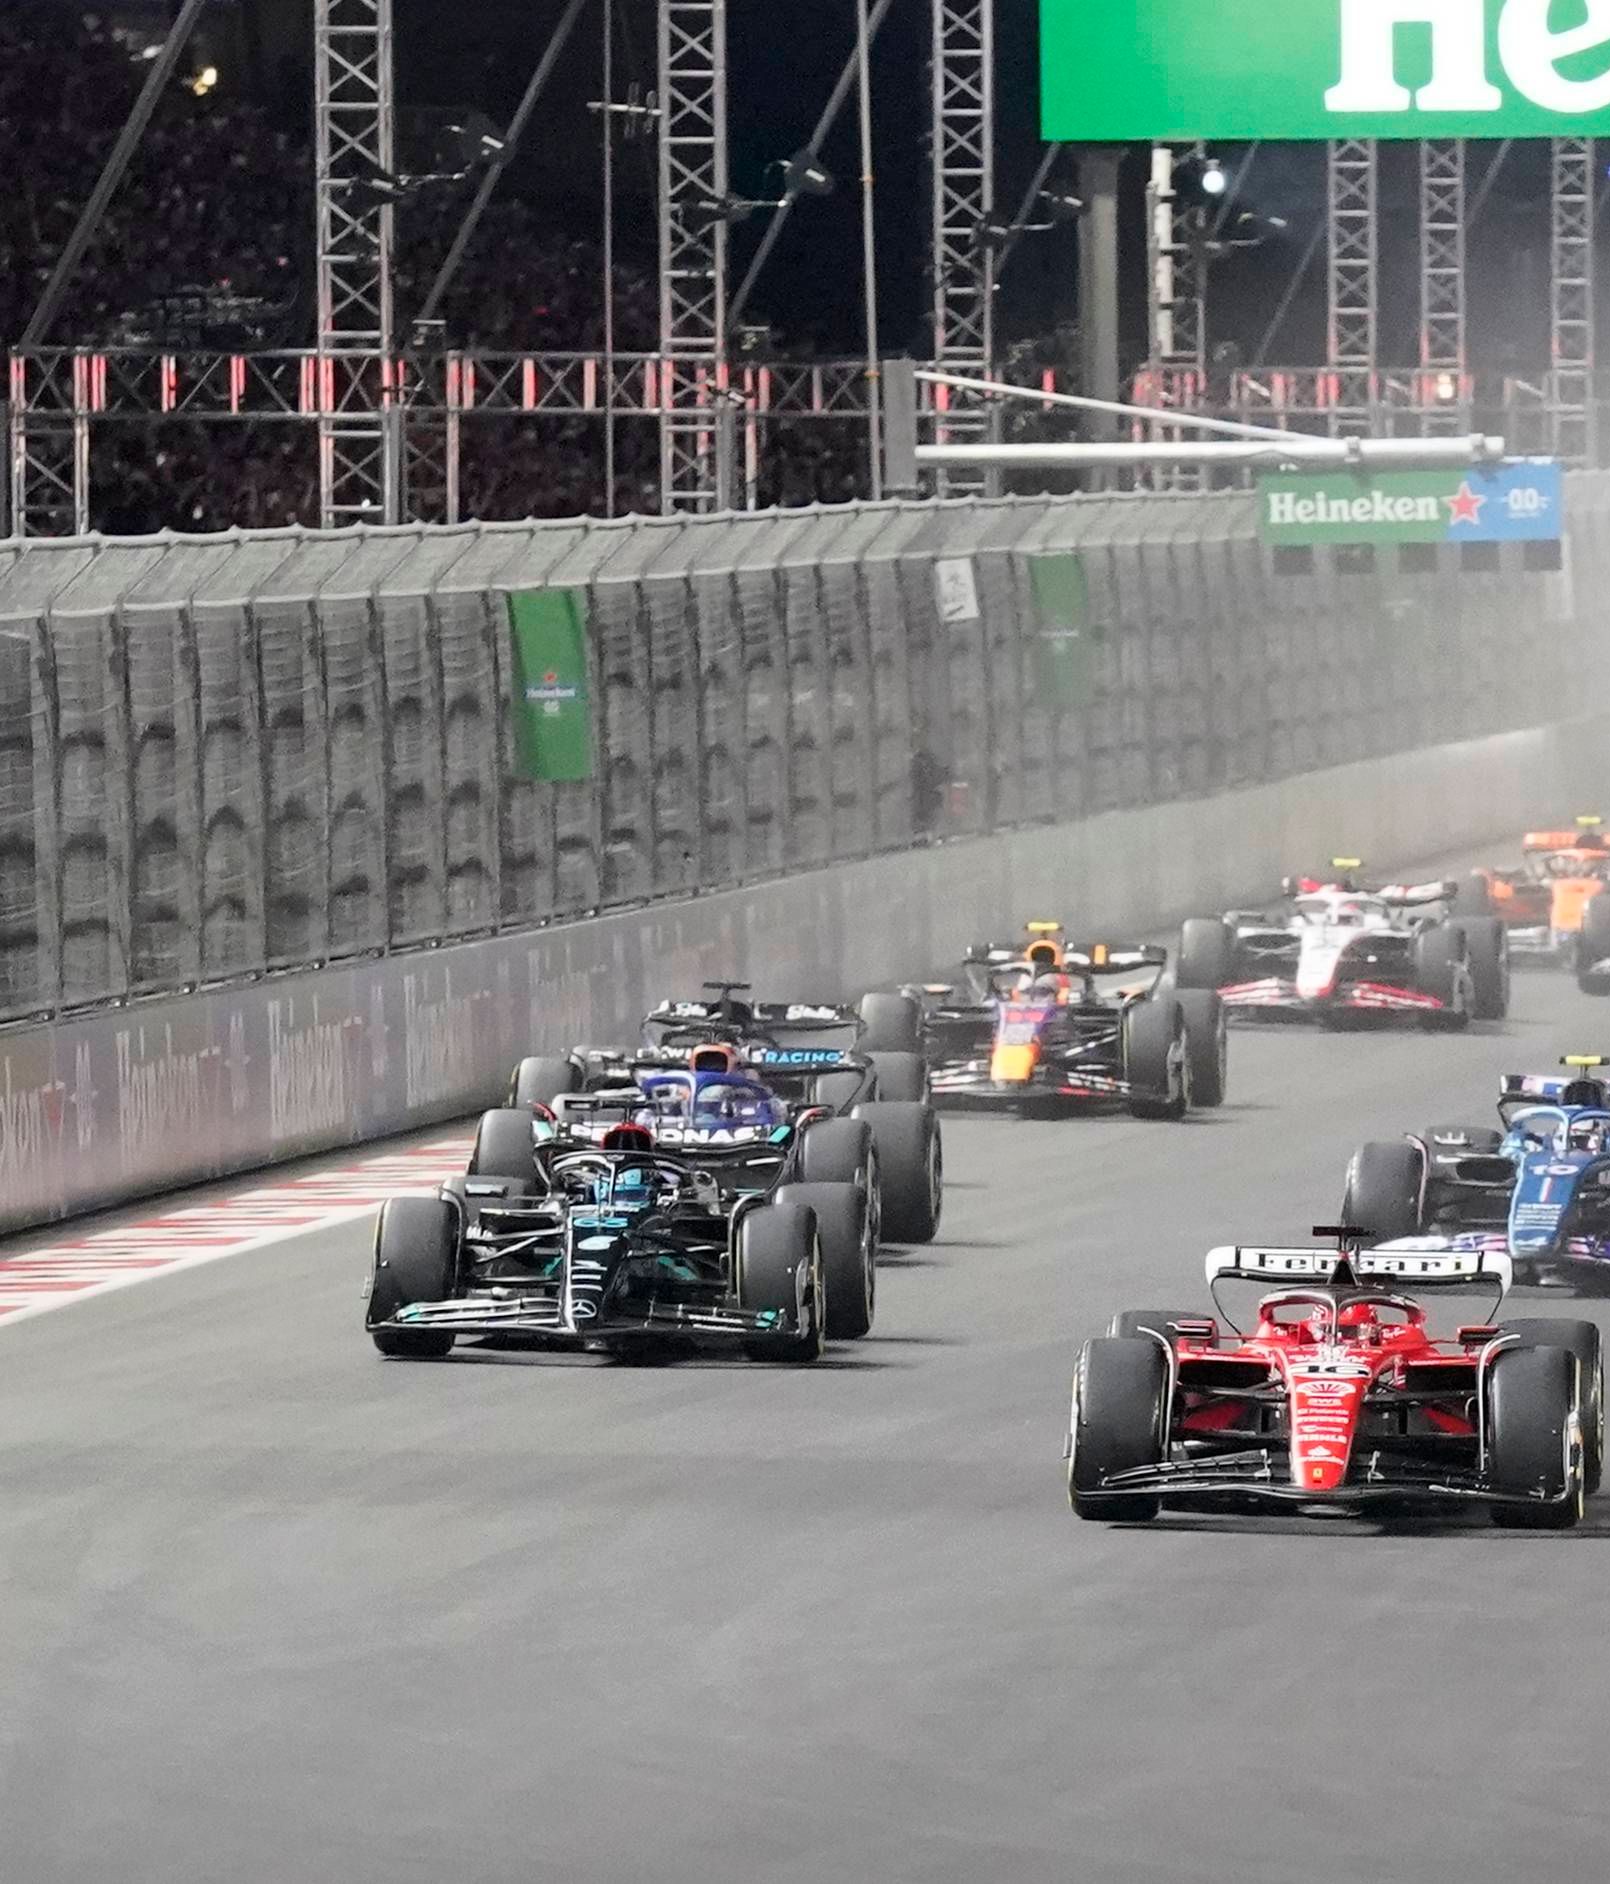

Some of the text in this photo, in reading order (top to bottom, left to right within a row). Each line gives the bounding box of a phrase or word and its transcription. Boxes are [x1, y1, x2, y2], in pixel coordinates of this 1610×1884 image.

[1268, 490, 1441, 524] Heineken
[765, 1050, 841, 1064] RACING
[1529, 1164, 1579, 1176] 10
[1256, 1253, 1464, 1274] Ferari
